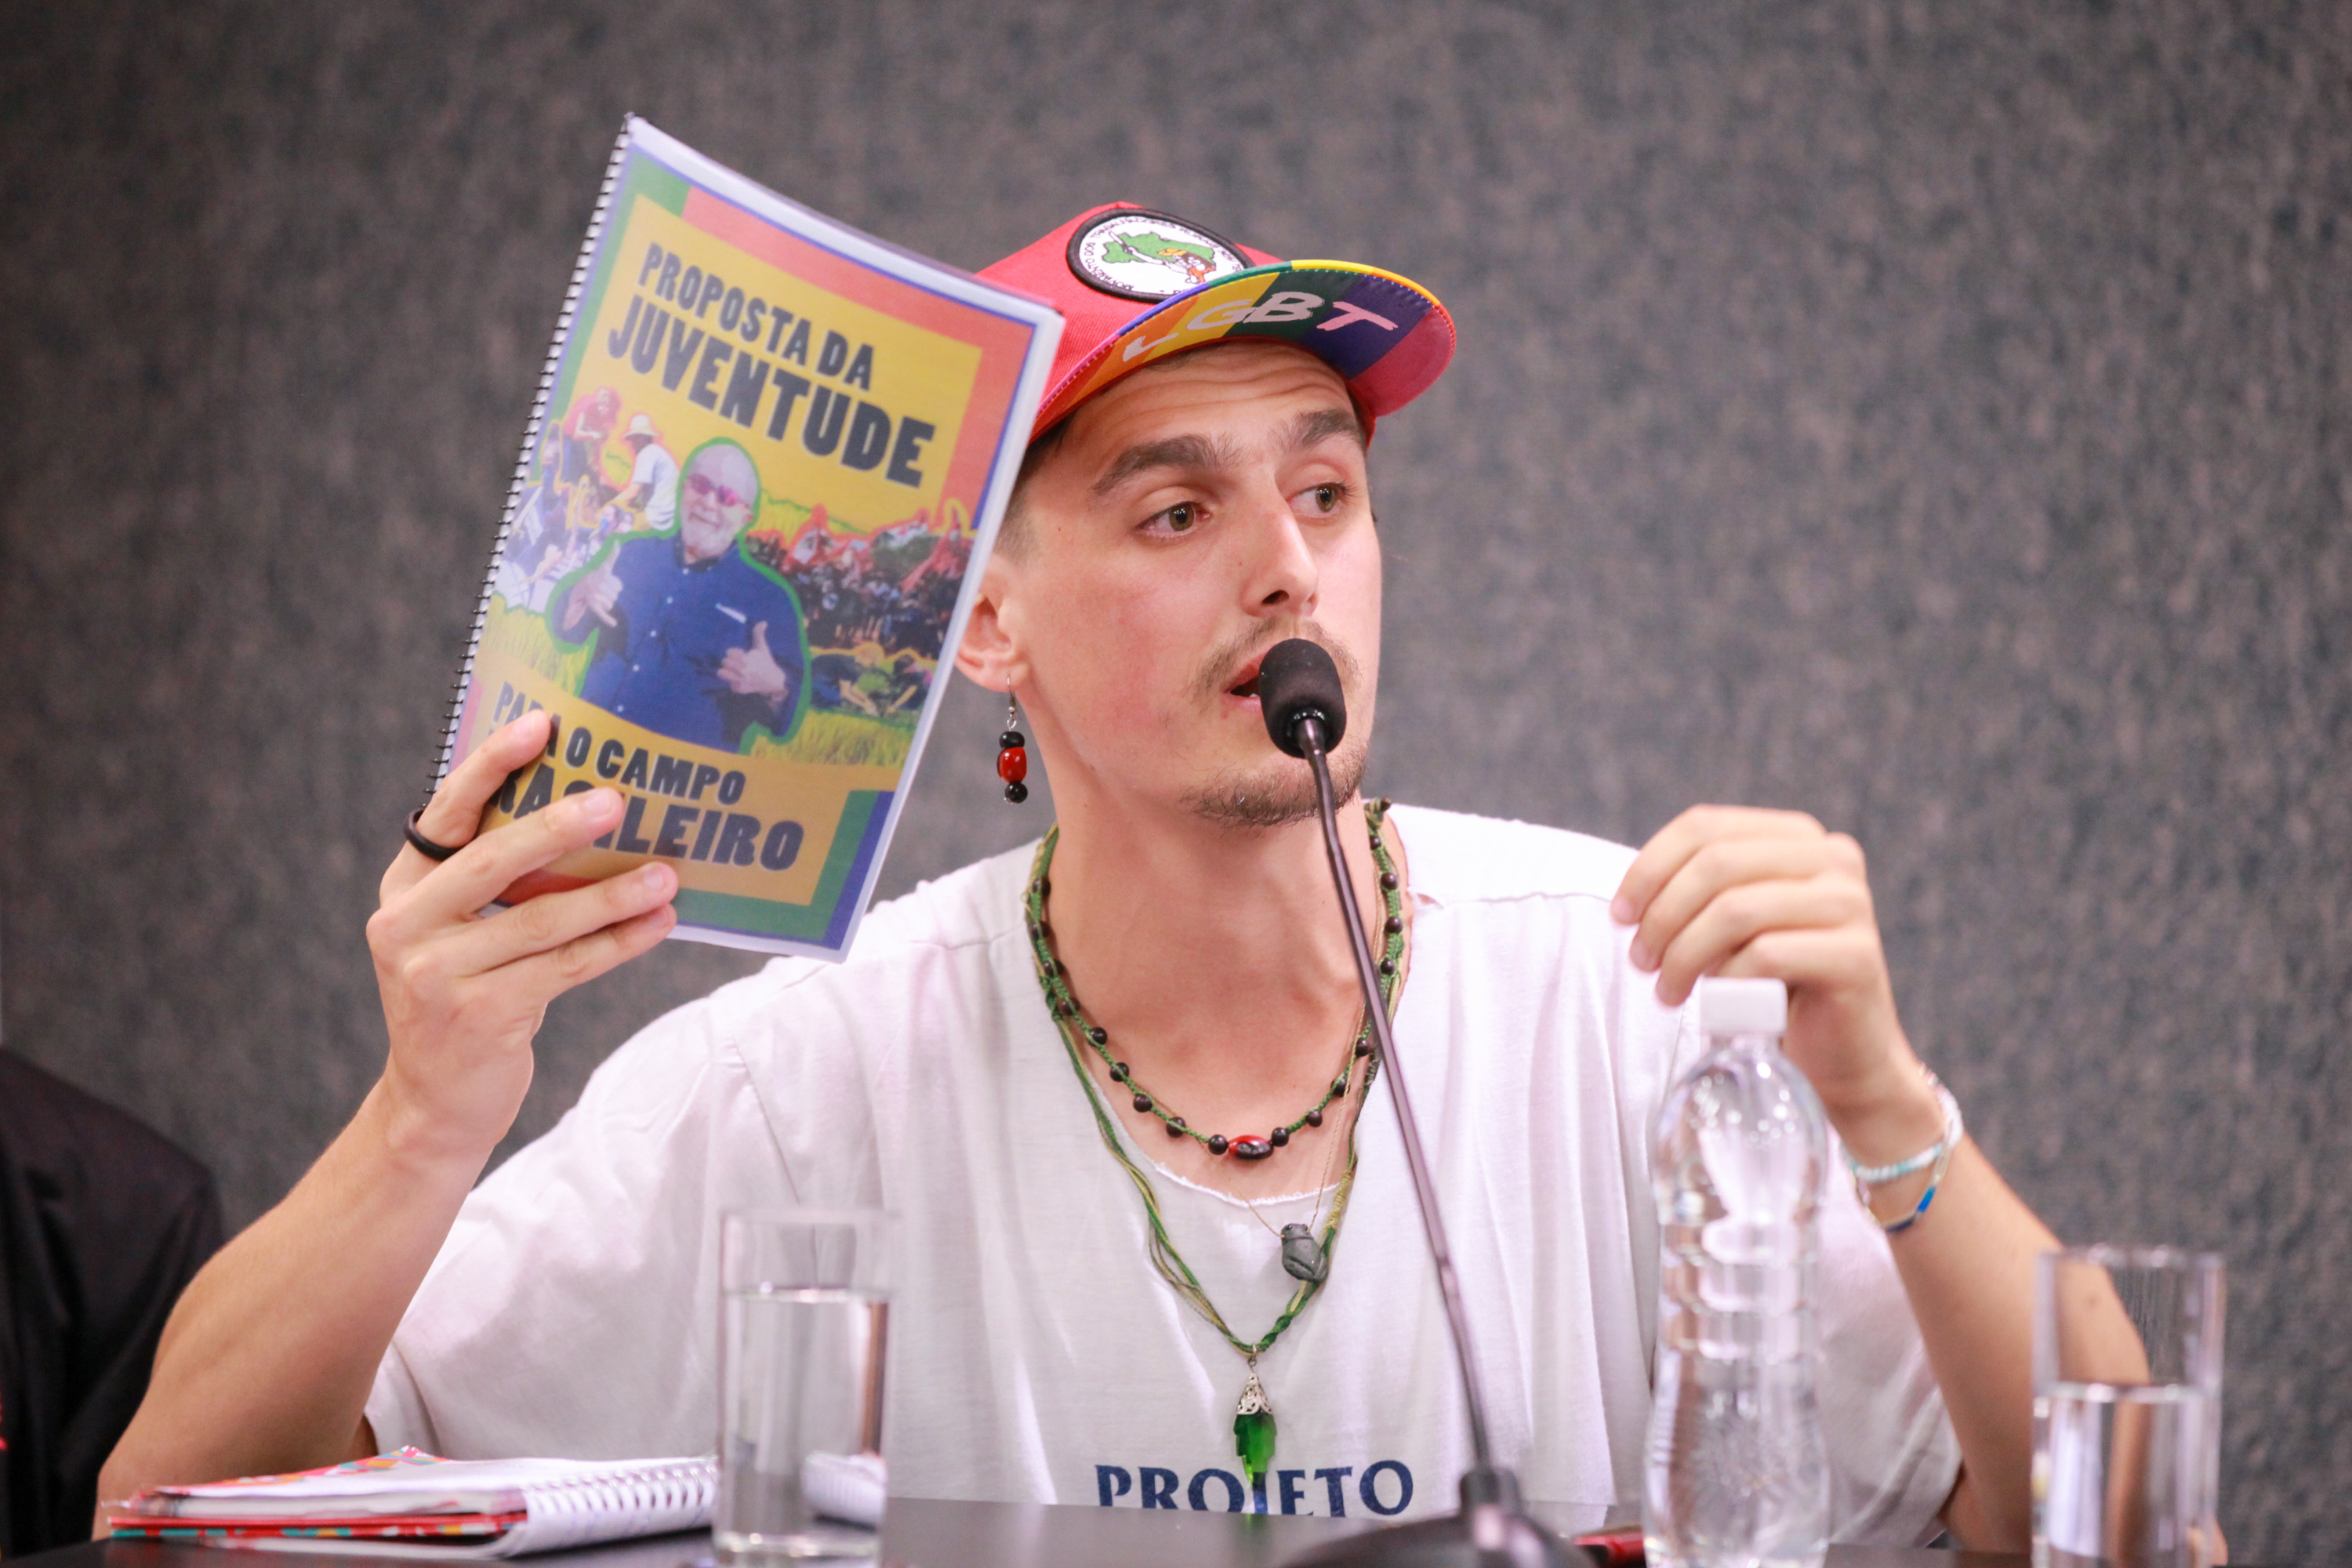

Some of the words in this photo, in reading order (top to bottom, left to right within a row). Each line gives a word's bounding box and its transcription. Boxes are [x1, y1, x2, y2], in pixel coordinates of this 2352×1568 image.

[1083, 241, 1096, 256] DOS
[637, 241, 811, 367] PROPOSTA
[816, 329, 874, 391] DA
[1122, 291, 1399, 362] LGBT
[607, 294, 936, 488] JUVENTUDE
[492, 681, 562, 759] PAA
[564, 726, 593, 768] O
[595, 739, 746, 806] CAMPO
